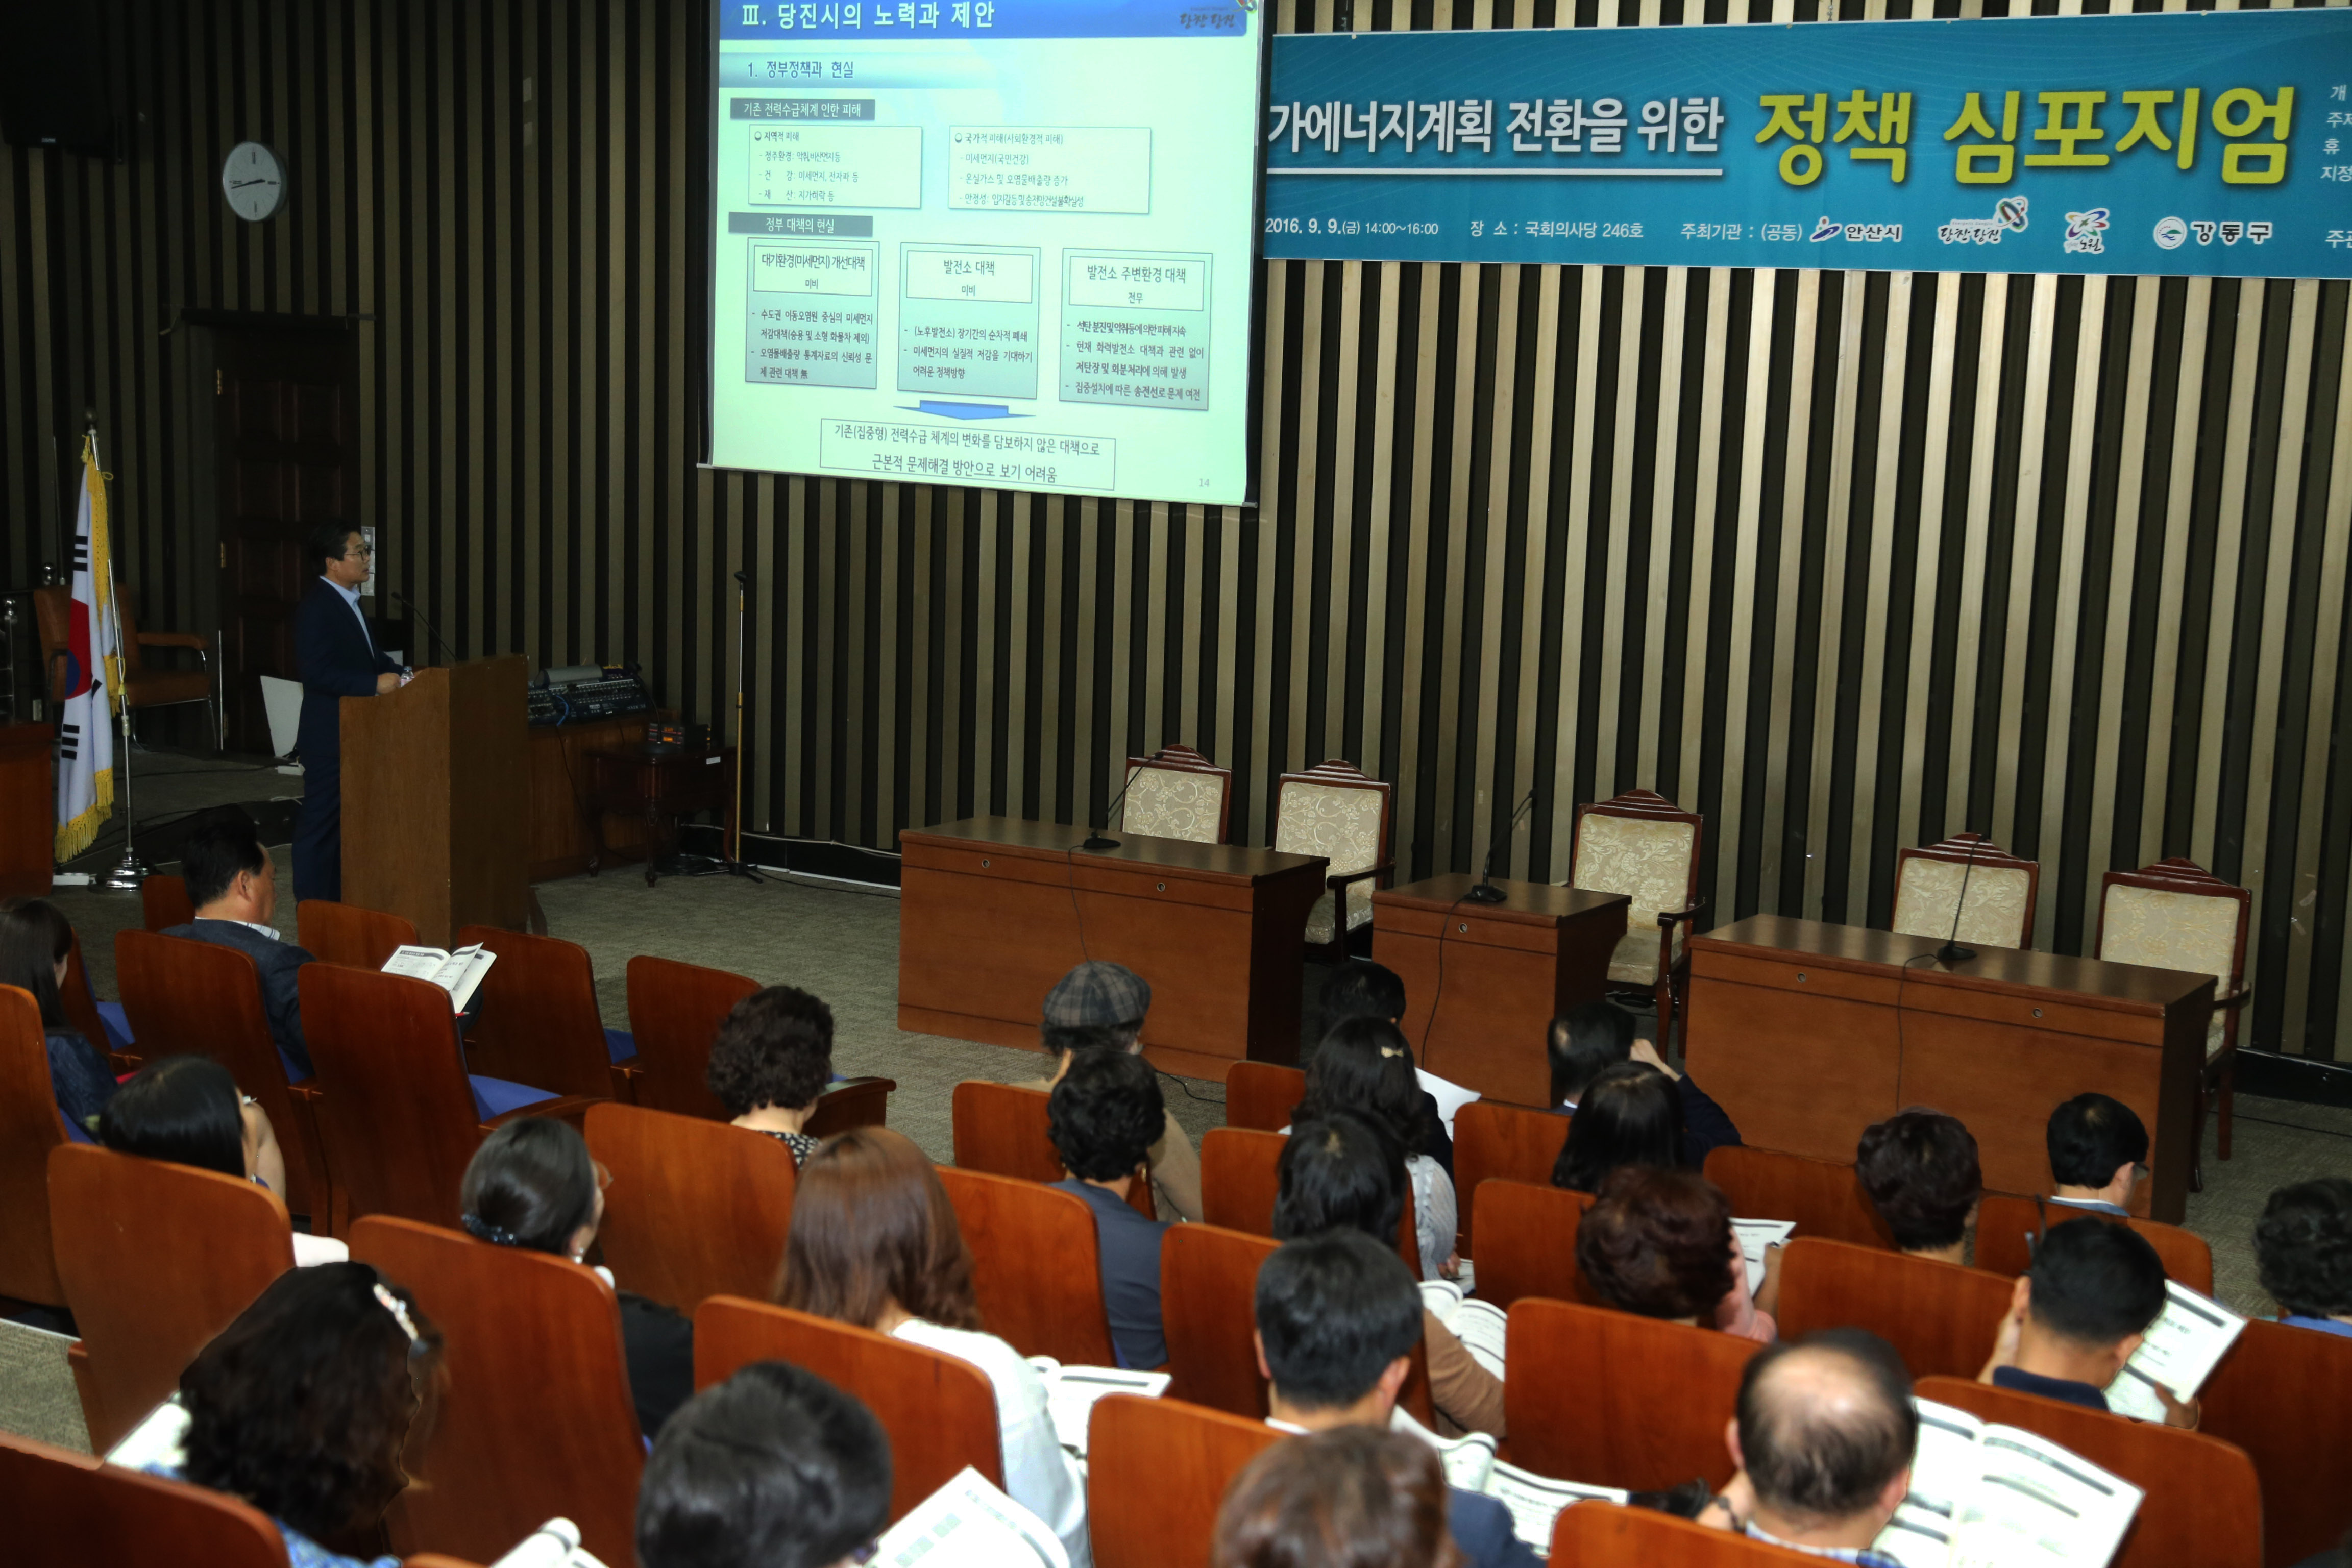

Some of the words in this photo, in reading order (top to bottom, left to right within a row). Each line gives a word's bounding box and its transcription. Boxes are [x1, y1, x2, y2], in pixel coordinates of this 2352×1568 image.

[778, 4, 861, 29] 당진시의
[874, 4, 940, 28] 노력과
[951, 2, 995, 28] 제안
[748, 62, 758, 77] 1.
[766, 61, 822, 79] 정부정책과
[831, 61, 853, 79] 현실
[2330, 84, 2346, 101] 개
[744, 103, 762, 117] 기존
[765, 103, 818, 117] 전력수급체계
[821, 104, 840, 117] 인한
[842, 104, 862, 117] 피해
[1506, 97, 1628, 152] 전환을
[1637, 97, 1724, 152] 위한
[764, 131, 783, 142] 지역적
[786, 131, 799, 142] 피해
[965, 133, 987, 144] 국가적
[1045, 134, 1063, 145] 피해)
[1755, 89, 1912, 186] 정책
[1944, 87, 2294, 184] 심포지엄
[2323, 138, 2340, 154] 휴
[966, 153, 1029, 165] 미세먼지(국민건강)
[829, 172, 849, 182] 전자파
[852, 172, 859, 183] 등
[965, 173, 994, 185] 온실가스
[996, 174, 1004, 185] 및
[1007, 174, 1051, 186] 오염물배출량
[1053, 175, 1068, 187] 증가
[798, 190, 825, 201] 지가하락
[828, 190, 835, 202] 등
[766, 217, 783, 232] 정부
[787, 218, 814, 234] 대책의
[817, 218, 835, 234] 현실
[1265, 217, 1302, 234] 2016.
[1308, 218, 1321, 234] 9.
[1365, 223, 1439, 235] 14:00~16:00
[1470, 221, 1484, 237] 장
[1493, 222, 1508, 235] 소
[1525, 221, 1597, 238] 국회의사당
[1603, 223, 1644, 238] 246호
[1681, 223, 1742, 241] 주최기관
[1761, 223, 1803, 242] (공동)
[1847, 226, 1901, 240] 안산시
[2194, 224, 2269, 242] 강동구
[1941, 227, 1971, 242] 당찬
[1973, 229, 1999, 242] 당진
[2080, 238, 2101, 251] 노원
[762, 253, 830, 269] 대기환경(미세먼지)
[832, 255, 865, 271] 개선대책
[944, 259, 972, 275] 발전소
[975, 260, 995, 276] 대책
[1088, 265, 1117, 281] 발전소
[1121, 266, 1162, 283] 주변환경
[1165, 267, 1186, 284] 대책
[805, 278, 818, 289] 미비
[962, 284, 975, 297] 미비
[1128, 292, 1143, 304] 전무
[761, 309, 781, 321] 수도권
[785, 310, 817, 323] 이동오염원
[822, 311, 842, 323] 중심의
[846, 313, 873, 325] 미세먼지
[805, 330, 812, 341] 및
[814, 331, 828, 342] 소형
[830, 331, 851, 344] 화물차
[853, 332, 870, 344] 제외)
[914, 326, 955, 339] (노후발전소)
[958, 327, 986, 340] 장기간의
[988, 330, 1010, 342] 순차적
[1012, 330, 1028, 342] 폐쇄
[761, 348, 800, 360] 오염물배출량
[804, 349, 838, 362] 통계자료의
[842, 351, 861, 364] 신뢰성
[865, 353, 872, 364] 문
[913, 345, 948, 358] 미세먼지의
[952, 347, 973, 360] 실질적
[977, 349, 999, 361] 저감을
[1003, 350, 1033, 363] 기대하기
[1077, 340, 1091, 353] 현재
[1097, 342, 1135, 355] 화력발전소
[1140, 345, 1164, 357] 대책과
[1169, 346, 1184, 358] 관련
[1189, 347, 1204, 359] 없이
[760, 366, 767, 377] 제
[769, 367, 782, 379] 관련
[785, 368, 798, 379] 대책
[913, 365, 934, 377] 어려운
[937, 366, 965, 379] 정책방향
[1076, 361, 1099, 374] 저탄장
[1101, 362, 1109, 374] 및
[1152, 365, 1168, 378] 의해
[1171, 367, 1187, 380] 발생
[1075, 381, 1113, 395] 집중설치에
[1115, 384, 1131, 397] 따른
[1134, 385, 1166, 398] 송전선로
[1168, 387, 1183, 400] 문제
[1185, 388, 1200, 401] 여전
[835, 424, 887, 441] 기존(집중형)
[890, 428, 928, 444] 전력수급
[930, 430, 959, 446] 체계의
[962, 432, 991, 449] 변화를
[994, 435, 1033, 452] 담보하지
[1037, 438, 1056, 454] 않은
[1060, 439, 1100, 456] 대책으로
[872, 453, 902, 471] 근본적
[906, 456, 948, 475] 문제해결
[953, 459, 995, 477] 방안으로
[999, 463, 1020, 480] 보기
[1025, 465, 1057, 483] 어려움
[1198, 478, 1210, 487] 14
